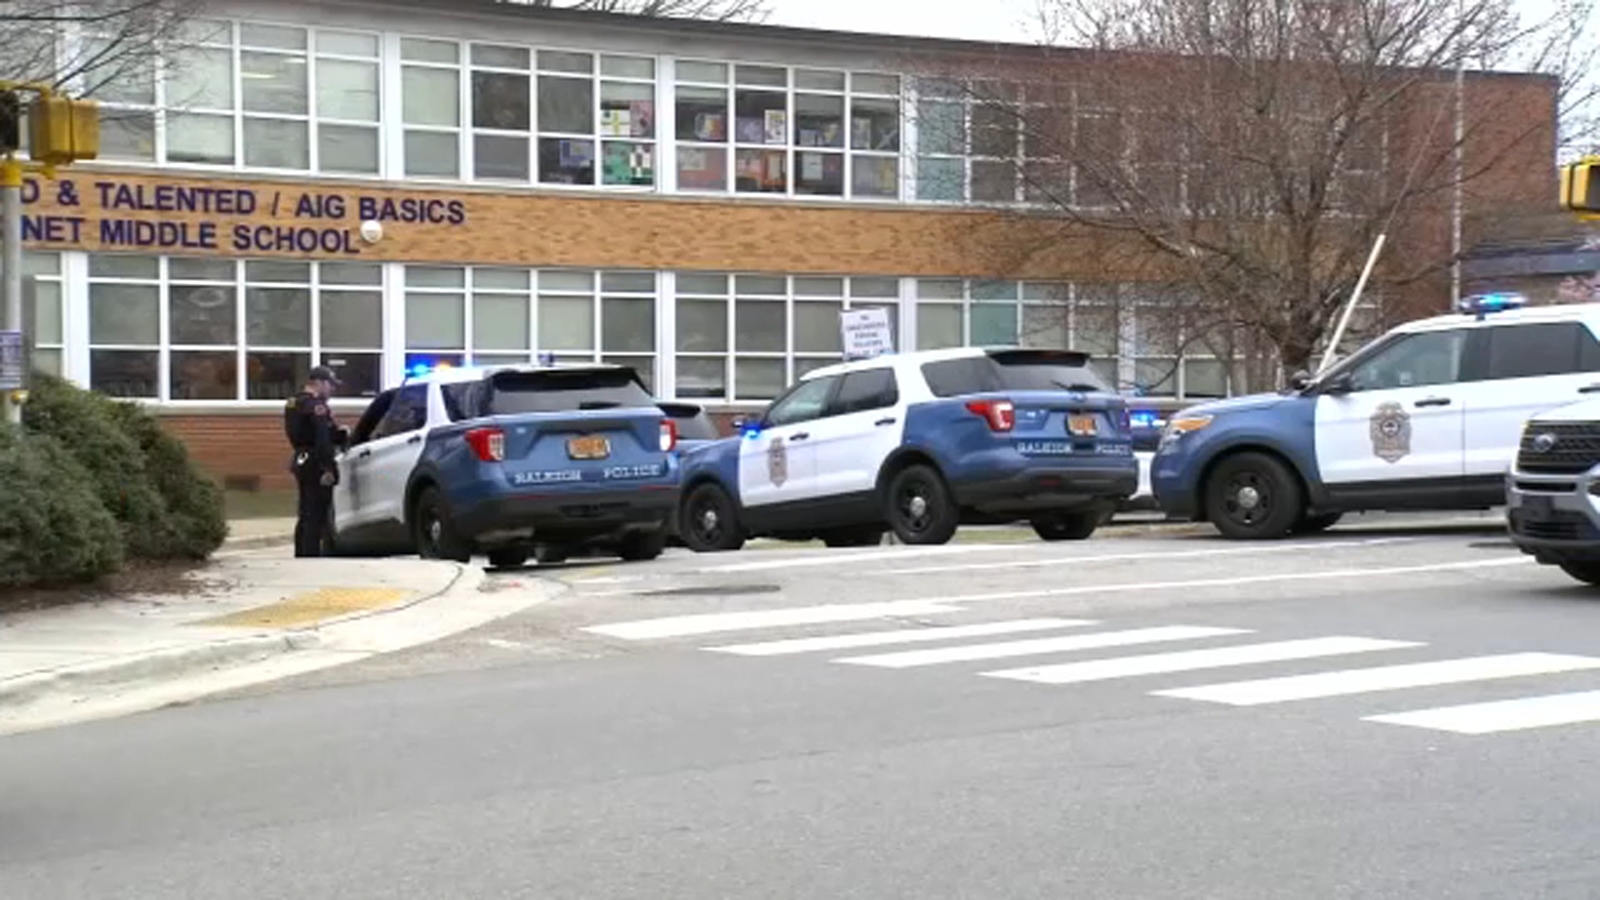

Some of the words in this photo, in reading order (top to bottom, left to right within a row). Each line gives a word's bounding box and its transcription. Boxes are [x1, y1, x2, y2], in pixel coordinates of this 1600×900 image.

[57, 180, 80, 206] &
[95, 182, 256, 215] TALENTED
[271, 191, 280, 217] /
[295, 193, 346, 219] AIG
[359, 197, 465, 225] BASICS
[21, 215, 86, 243] NET
[100, 219, 218, 249] MIDDLE
[233, 225, 360, 254] SCHOOL
[603, 465, 661, 479] POLICE
